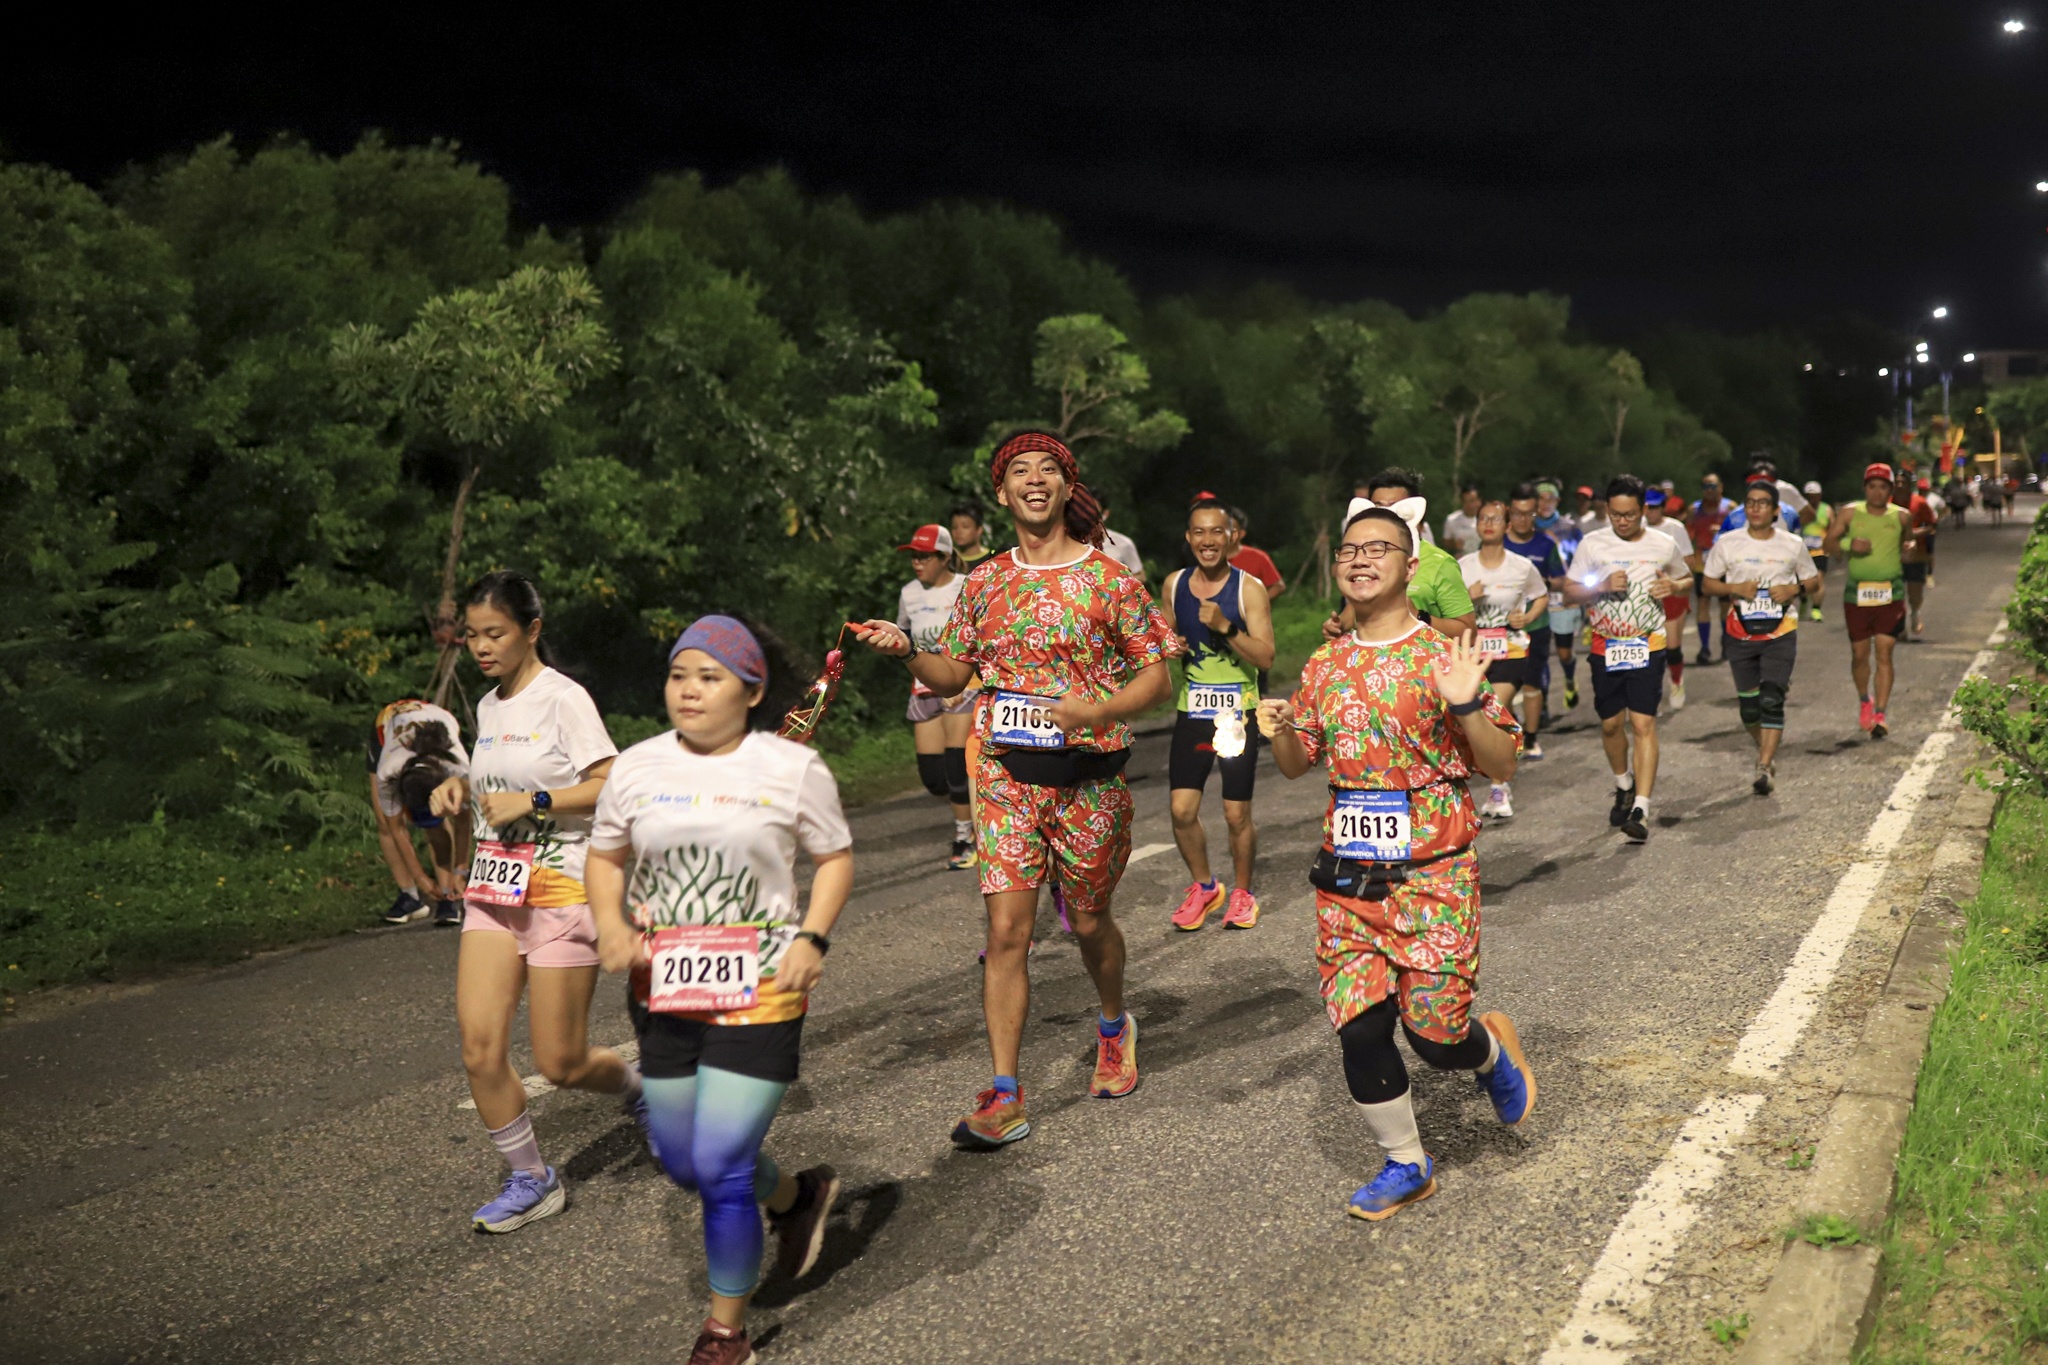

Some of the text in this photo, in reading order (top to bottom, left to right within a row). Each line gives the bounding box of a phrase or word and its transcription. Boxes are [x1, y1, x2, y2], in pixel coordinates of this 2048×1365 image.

[1611, 649, 1645, 661] 21255
[1195, 693, 1235, 708] 21019
[1341, 814, 1398, 839] 21613
[474, 858, 523, 885] 20282
[664, 955, 743, 984] 20281
